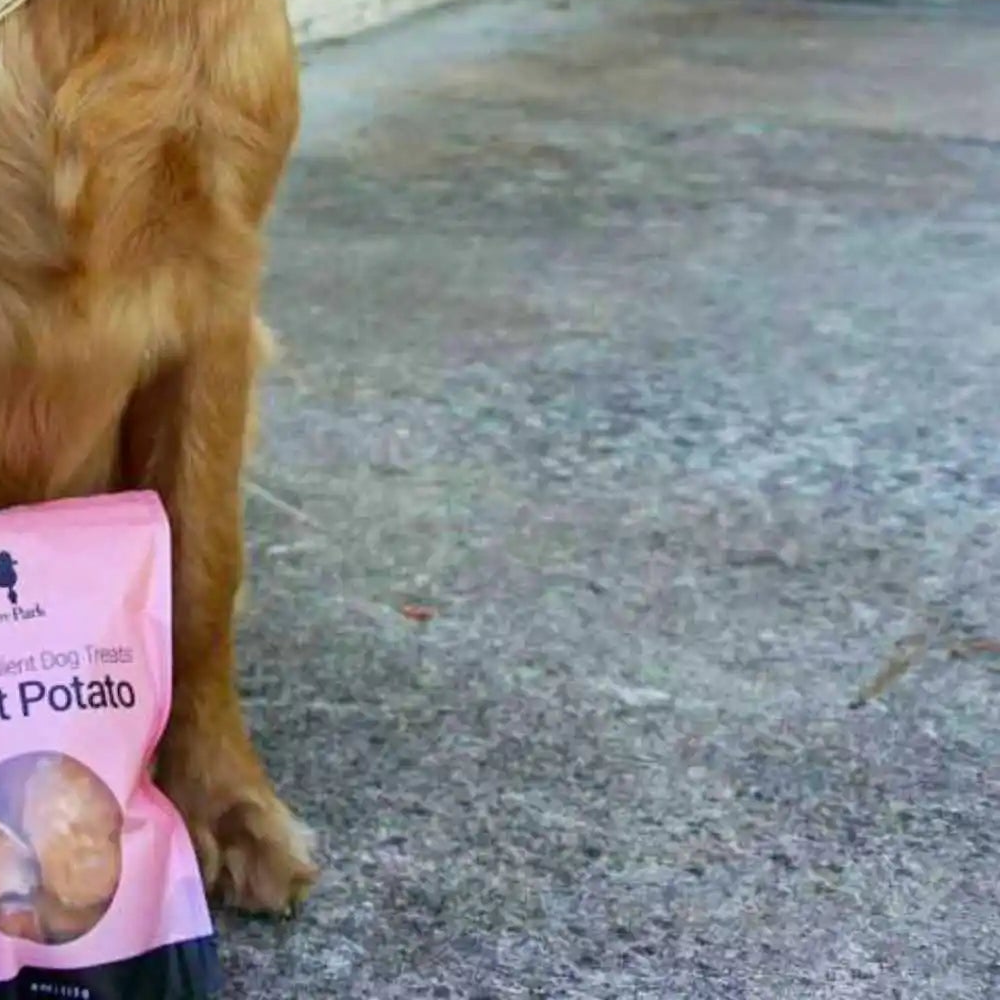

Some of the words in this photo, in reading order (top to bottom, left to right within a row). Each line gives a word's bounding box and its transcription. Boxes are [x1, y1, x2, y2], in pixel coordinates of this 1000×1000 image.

[41, 649, 80, 673] Dog
[84, 644, 134, 666] Treats
[18, 674, 136, 718] Potato
